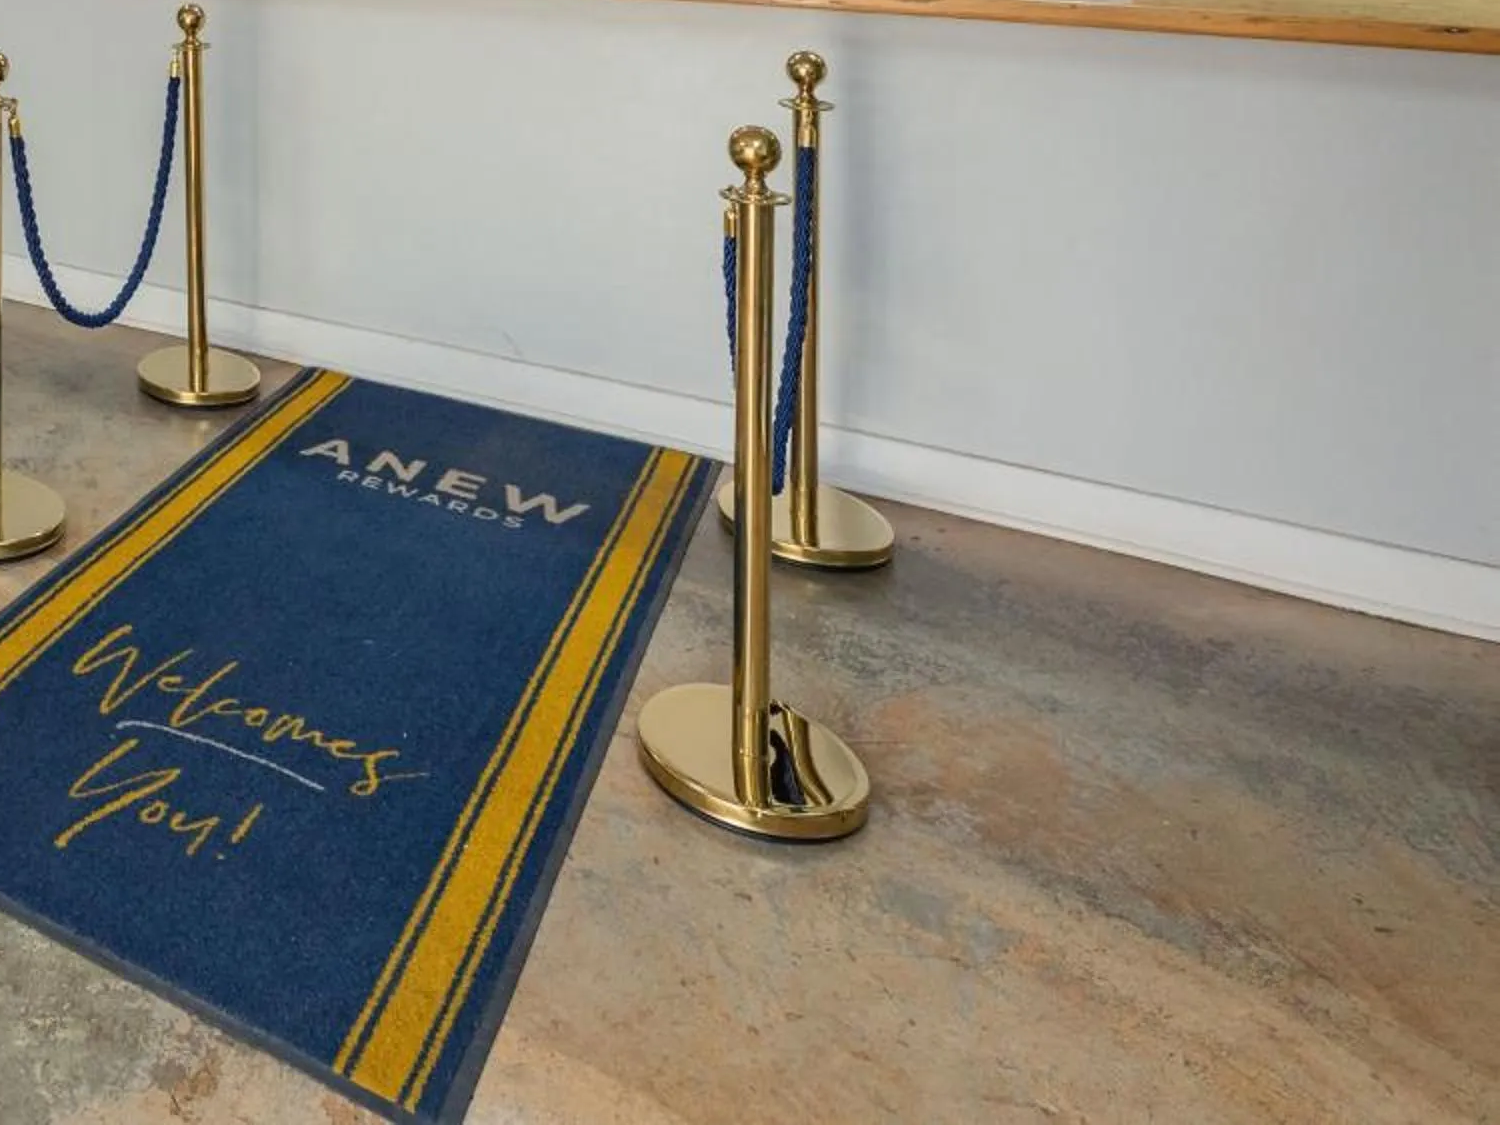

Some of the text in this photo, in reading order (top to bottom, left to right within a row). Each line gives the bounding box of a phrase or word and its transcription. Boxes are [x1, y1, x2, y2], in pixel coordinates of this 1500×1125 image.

[300, 439, 591, 525] ANEW
[336, 470, 523, 528] REWARDS
[73, 625, 430, 795] Welcomes
[54, 738, 263, 860] You!
